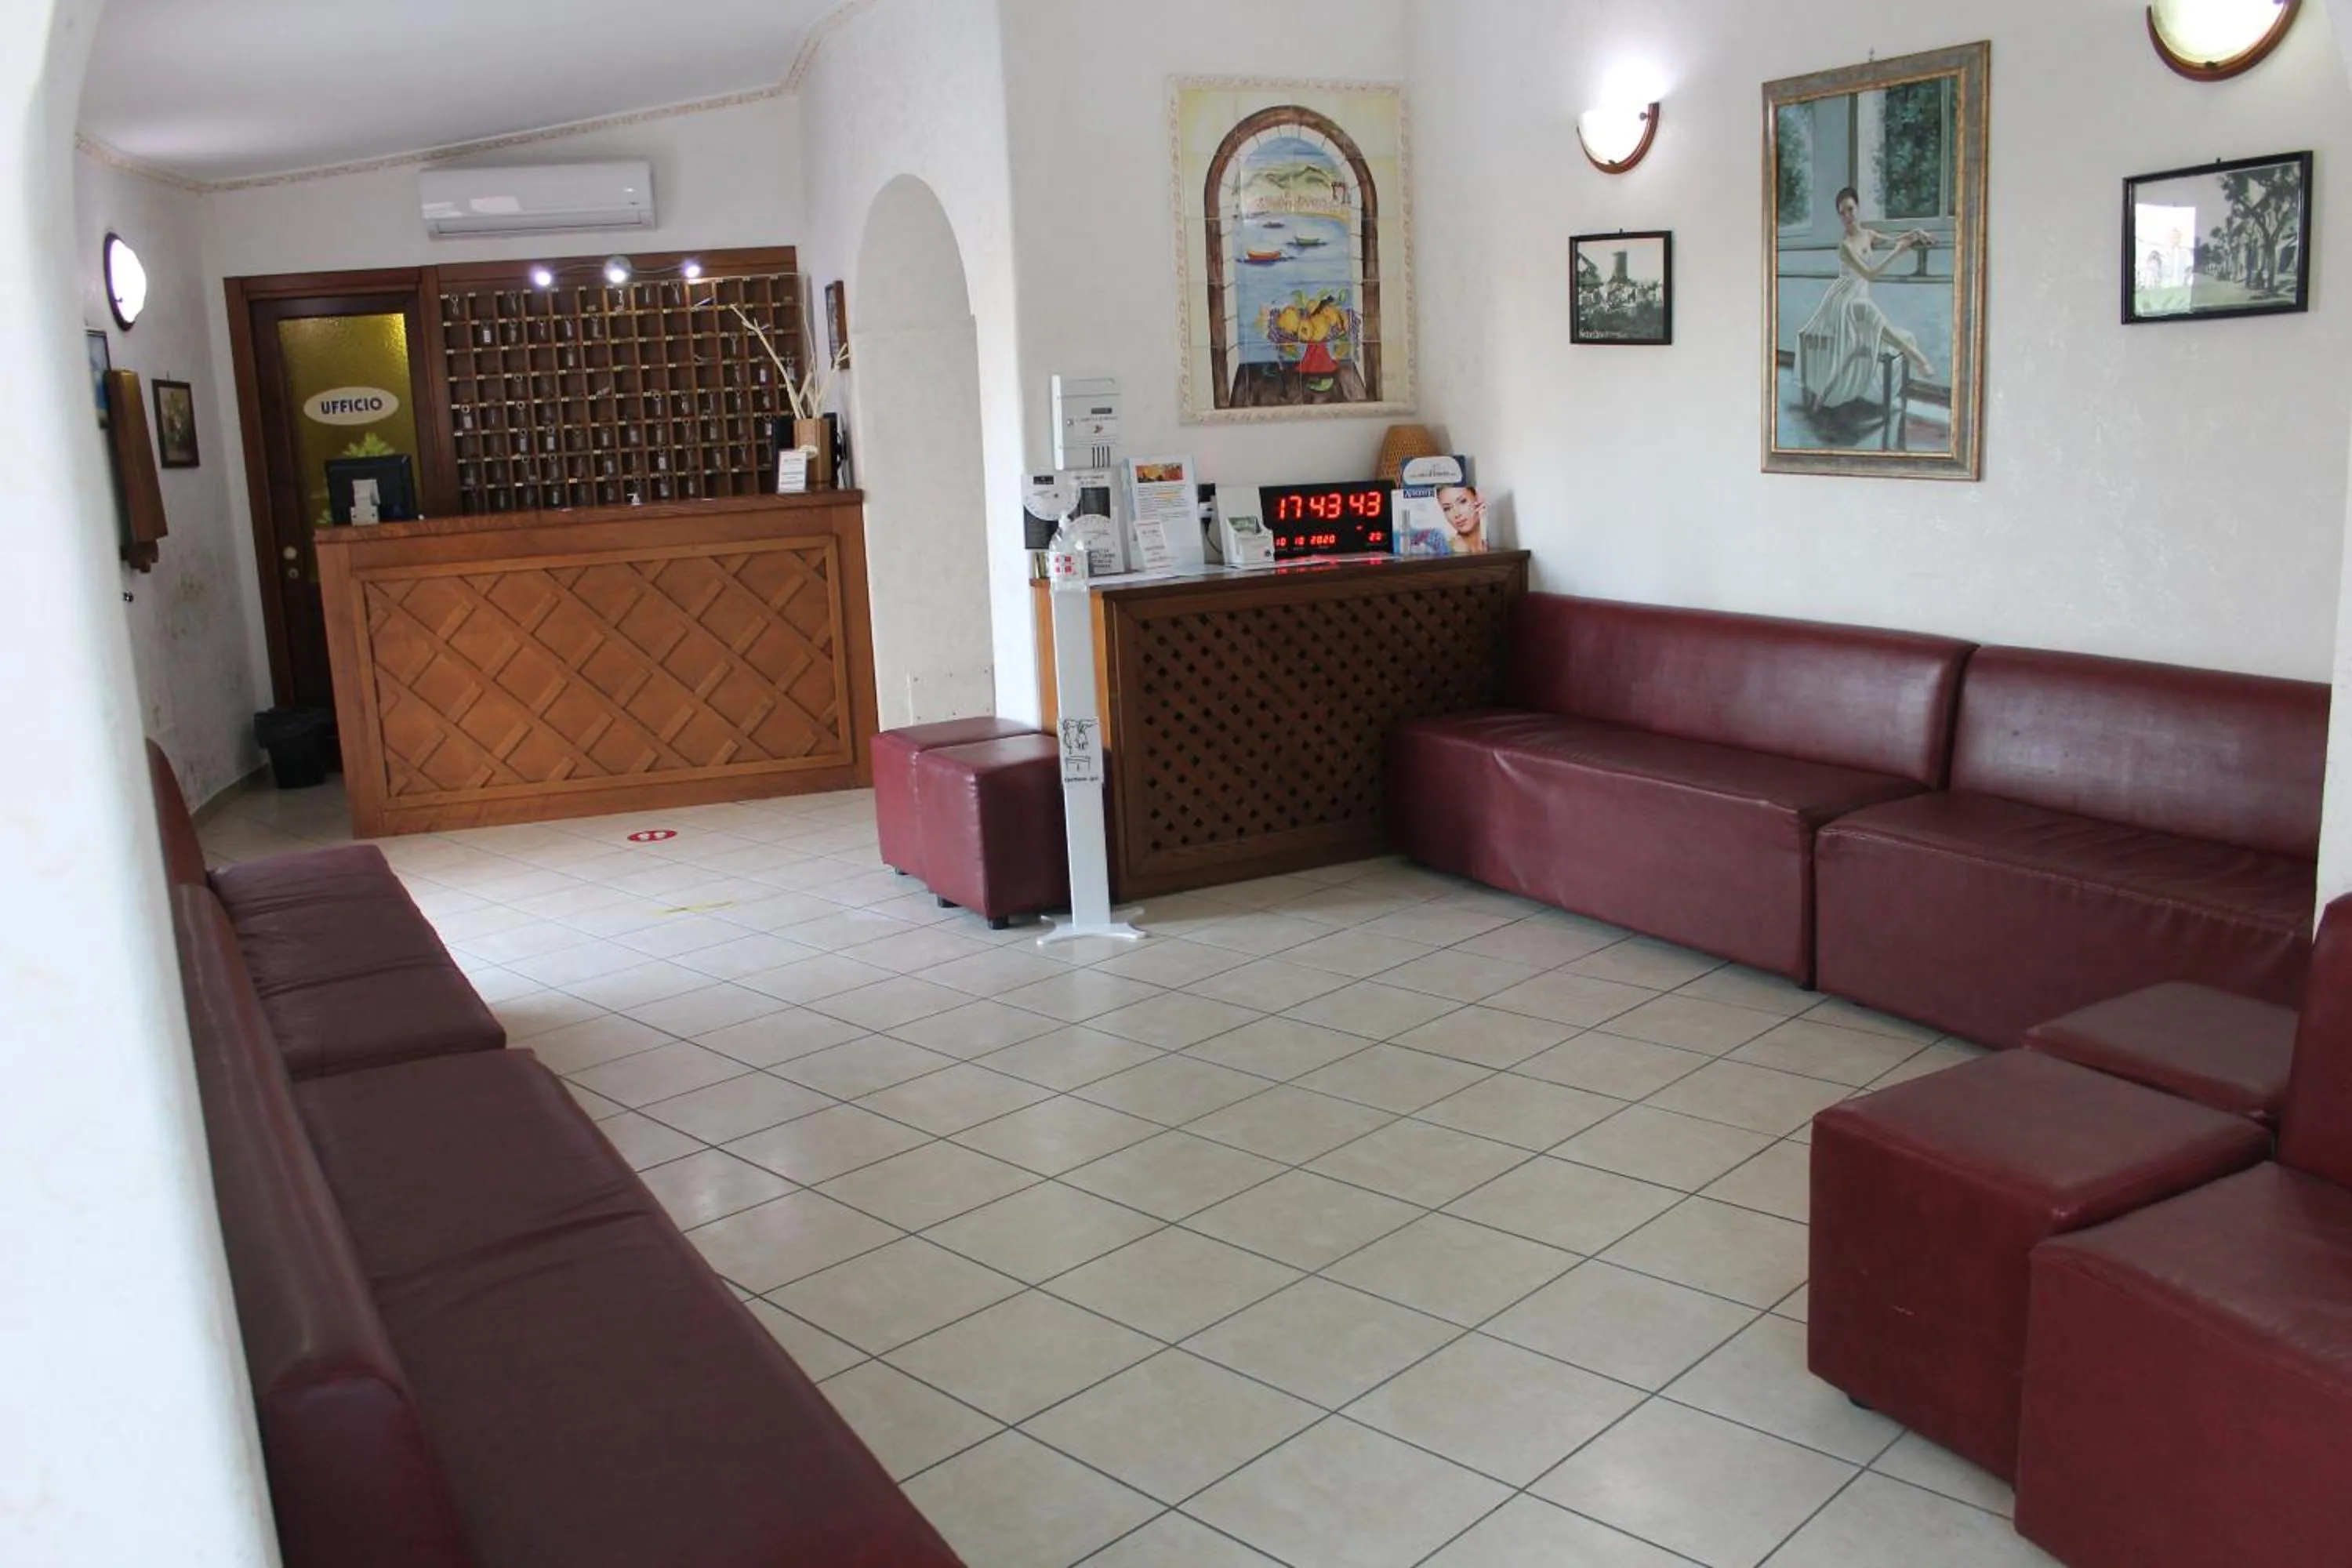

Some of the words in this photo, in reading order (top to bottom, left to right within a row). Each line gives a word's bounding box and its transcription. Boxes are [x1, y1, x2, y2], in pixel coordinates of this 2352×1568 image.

[320, 397, 383, 414] UFFICIO
[1279, 495, 1303, 520] 17
[1309, 493, 1342, 519] 43
[1348, 491, 1381, 517] 43
